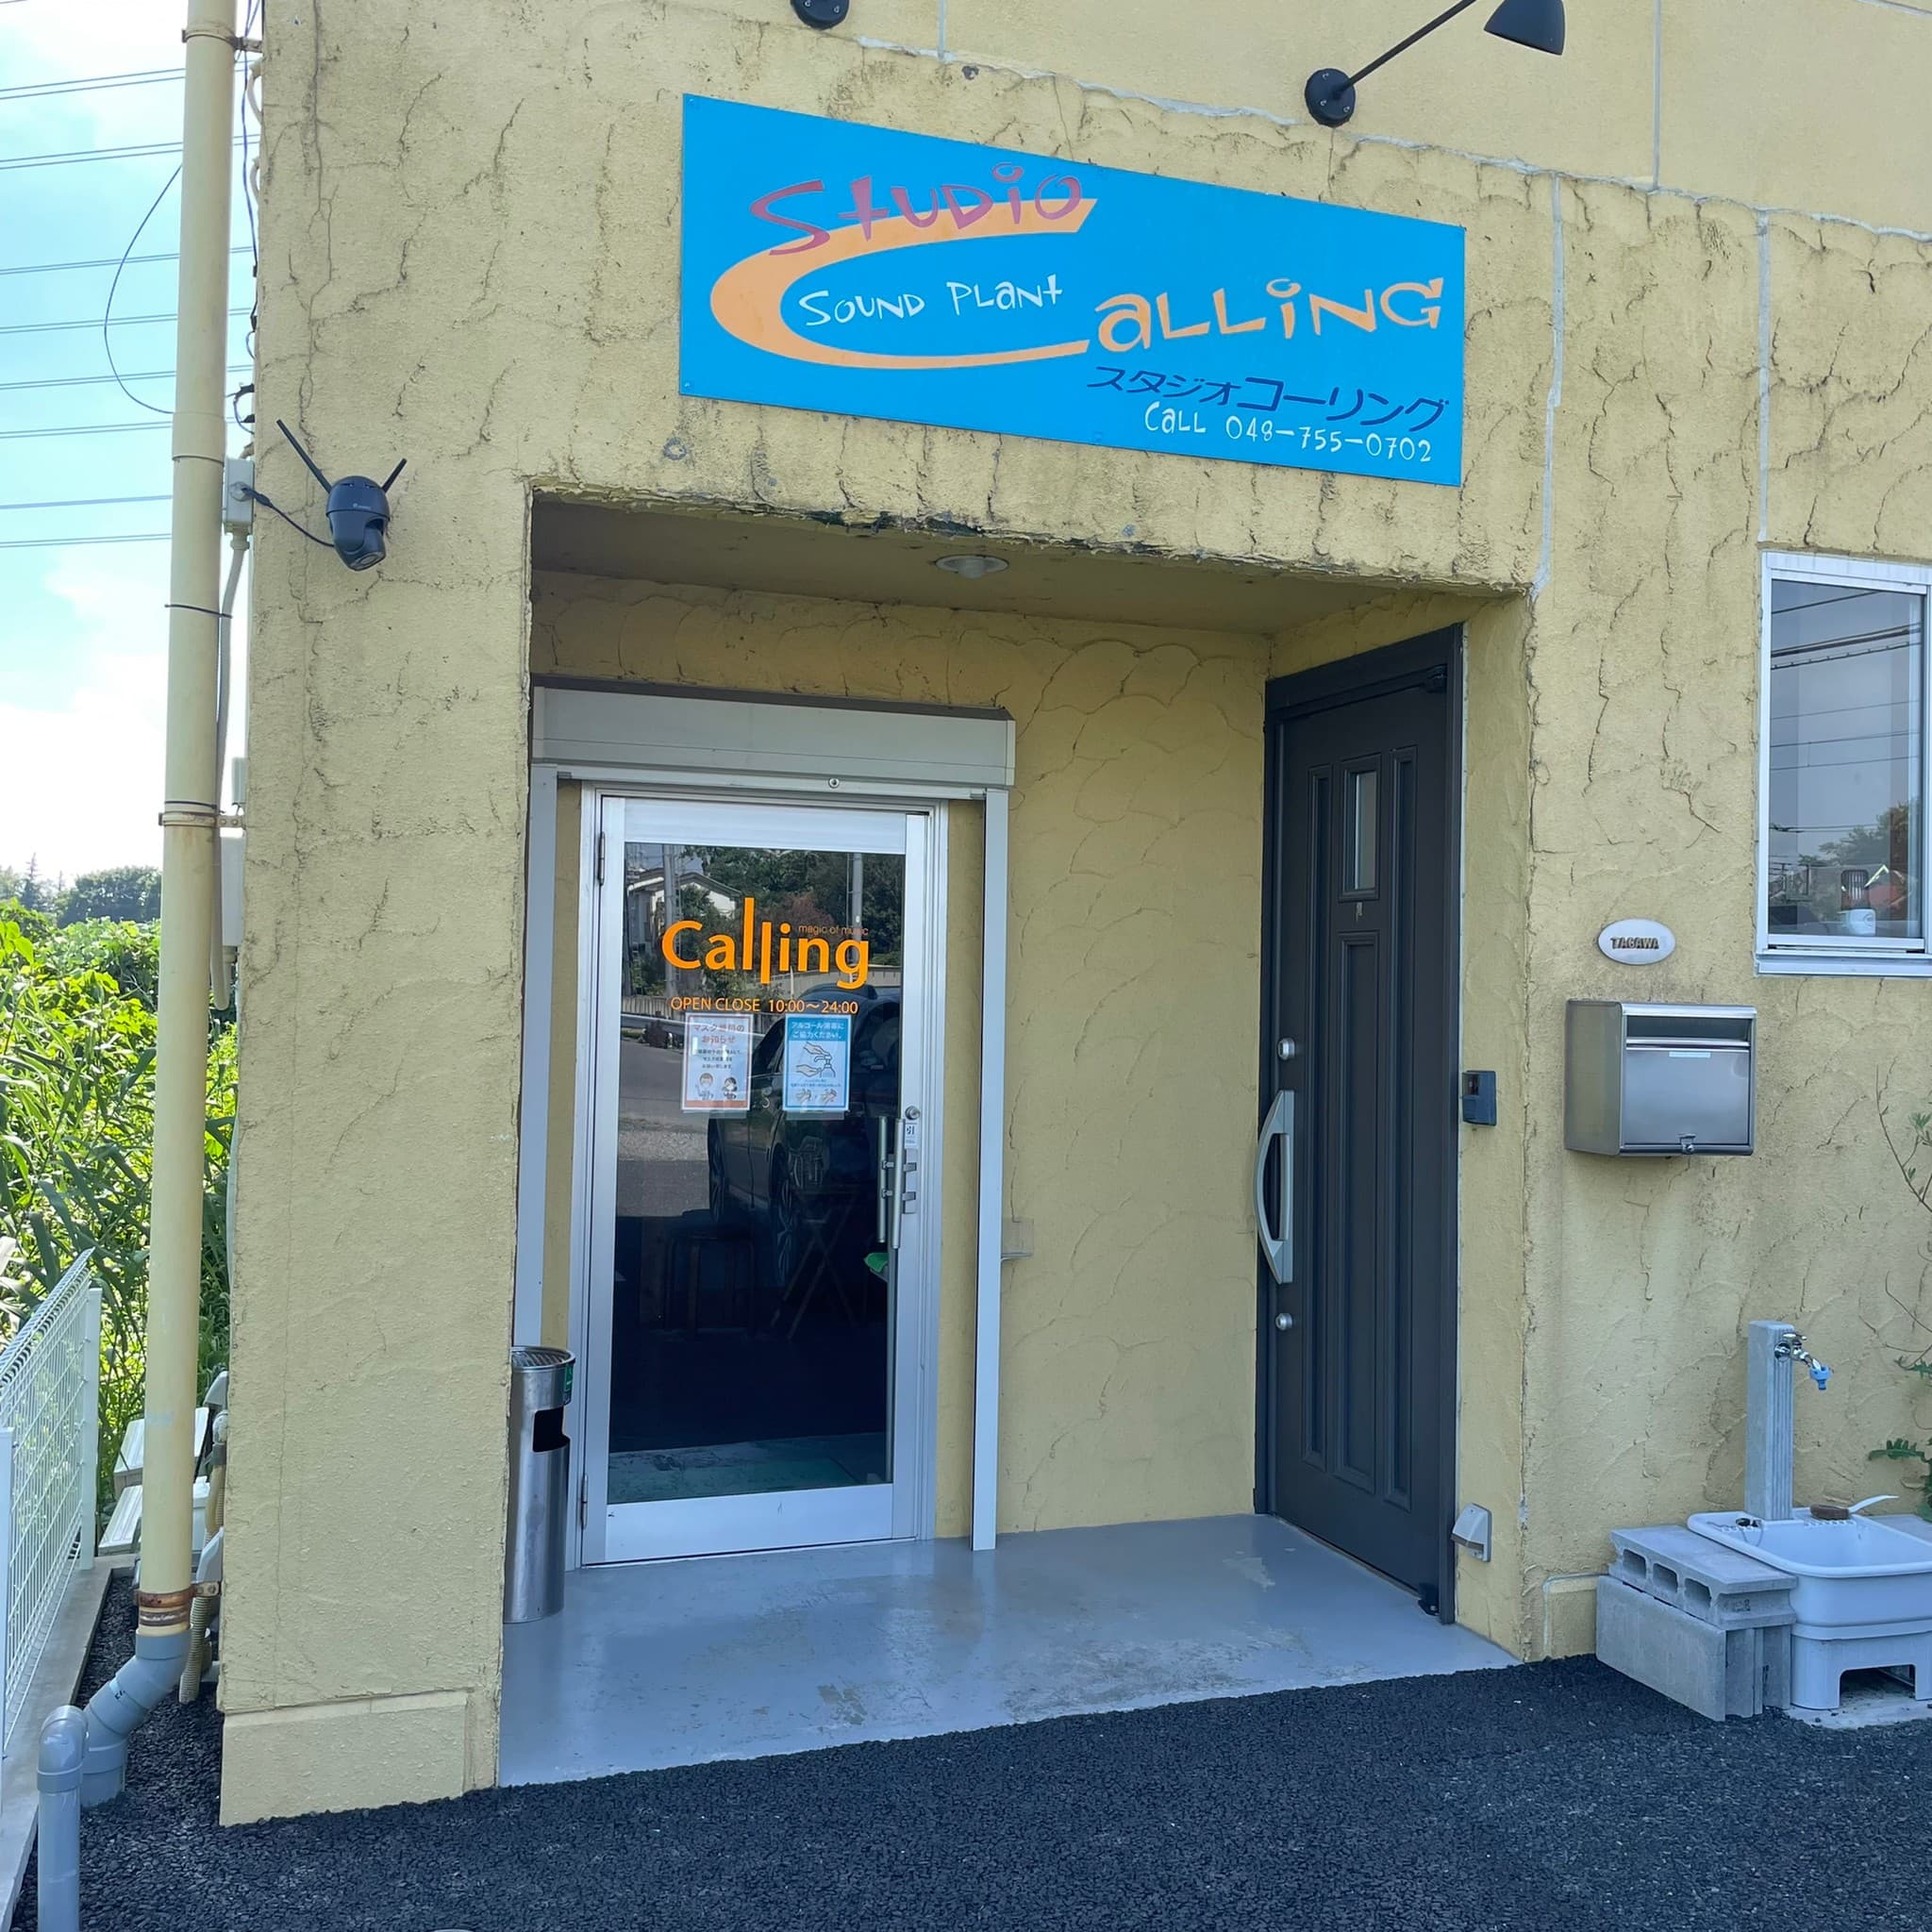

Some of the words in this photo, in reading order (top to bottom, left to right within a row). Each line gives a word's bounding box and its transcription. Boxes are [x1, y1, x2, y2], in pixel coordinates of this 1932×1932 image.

[799, 290, 925, 326] SOUND
[1087, 366, 1450, 432] スタジオコーリング
[1225, 415, 1431, 462] 048-755-0702
[661, 897, 869, 990] Calling
[1610, 937, 1659, 949] TAGAWA
[671, 996, 711, 1011] OPEN
[715, 998, 760, 1013] CLOSE
